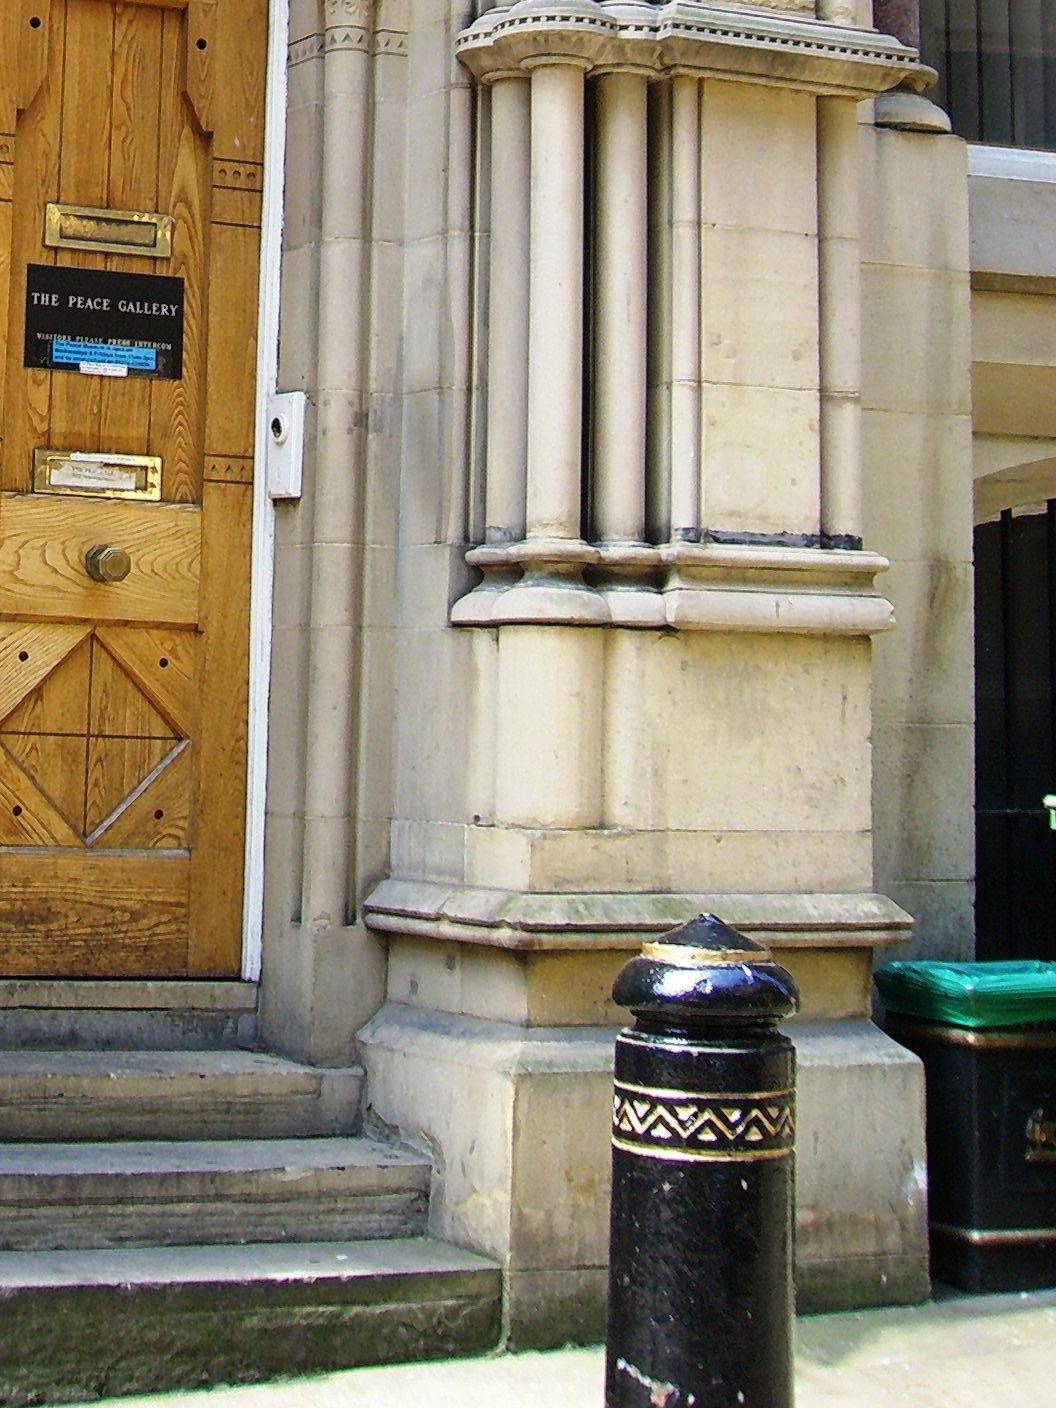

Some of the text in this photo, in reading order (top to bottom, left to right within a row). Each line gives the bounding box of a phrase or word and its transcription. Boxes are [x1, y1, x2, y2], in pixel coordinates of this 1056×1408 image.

[31, 291, 180, 318] THE PEACE GALLERY
